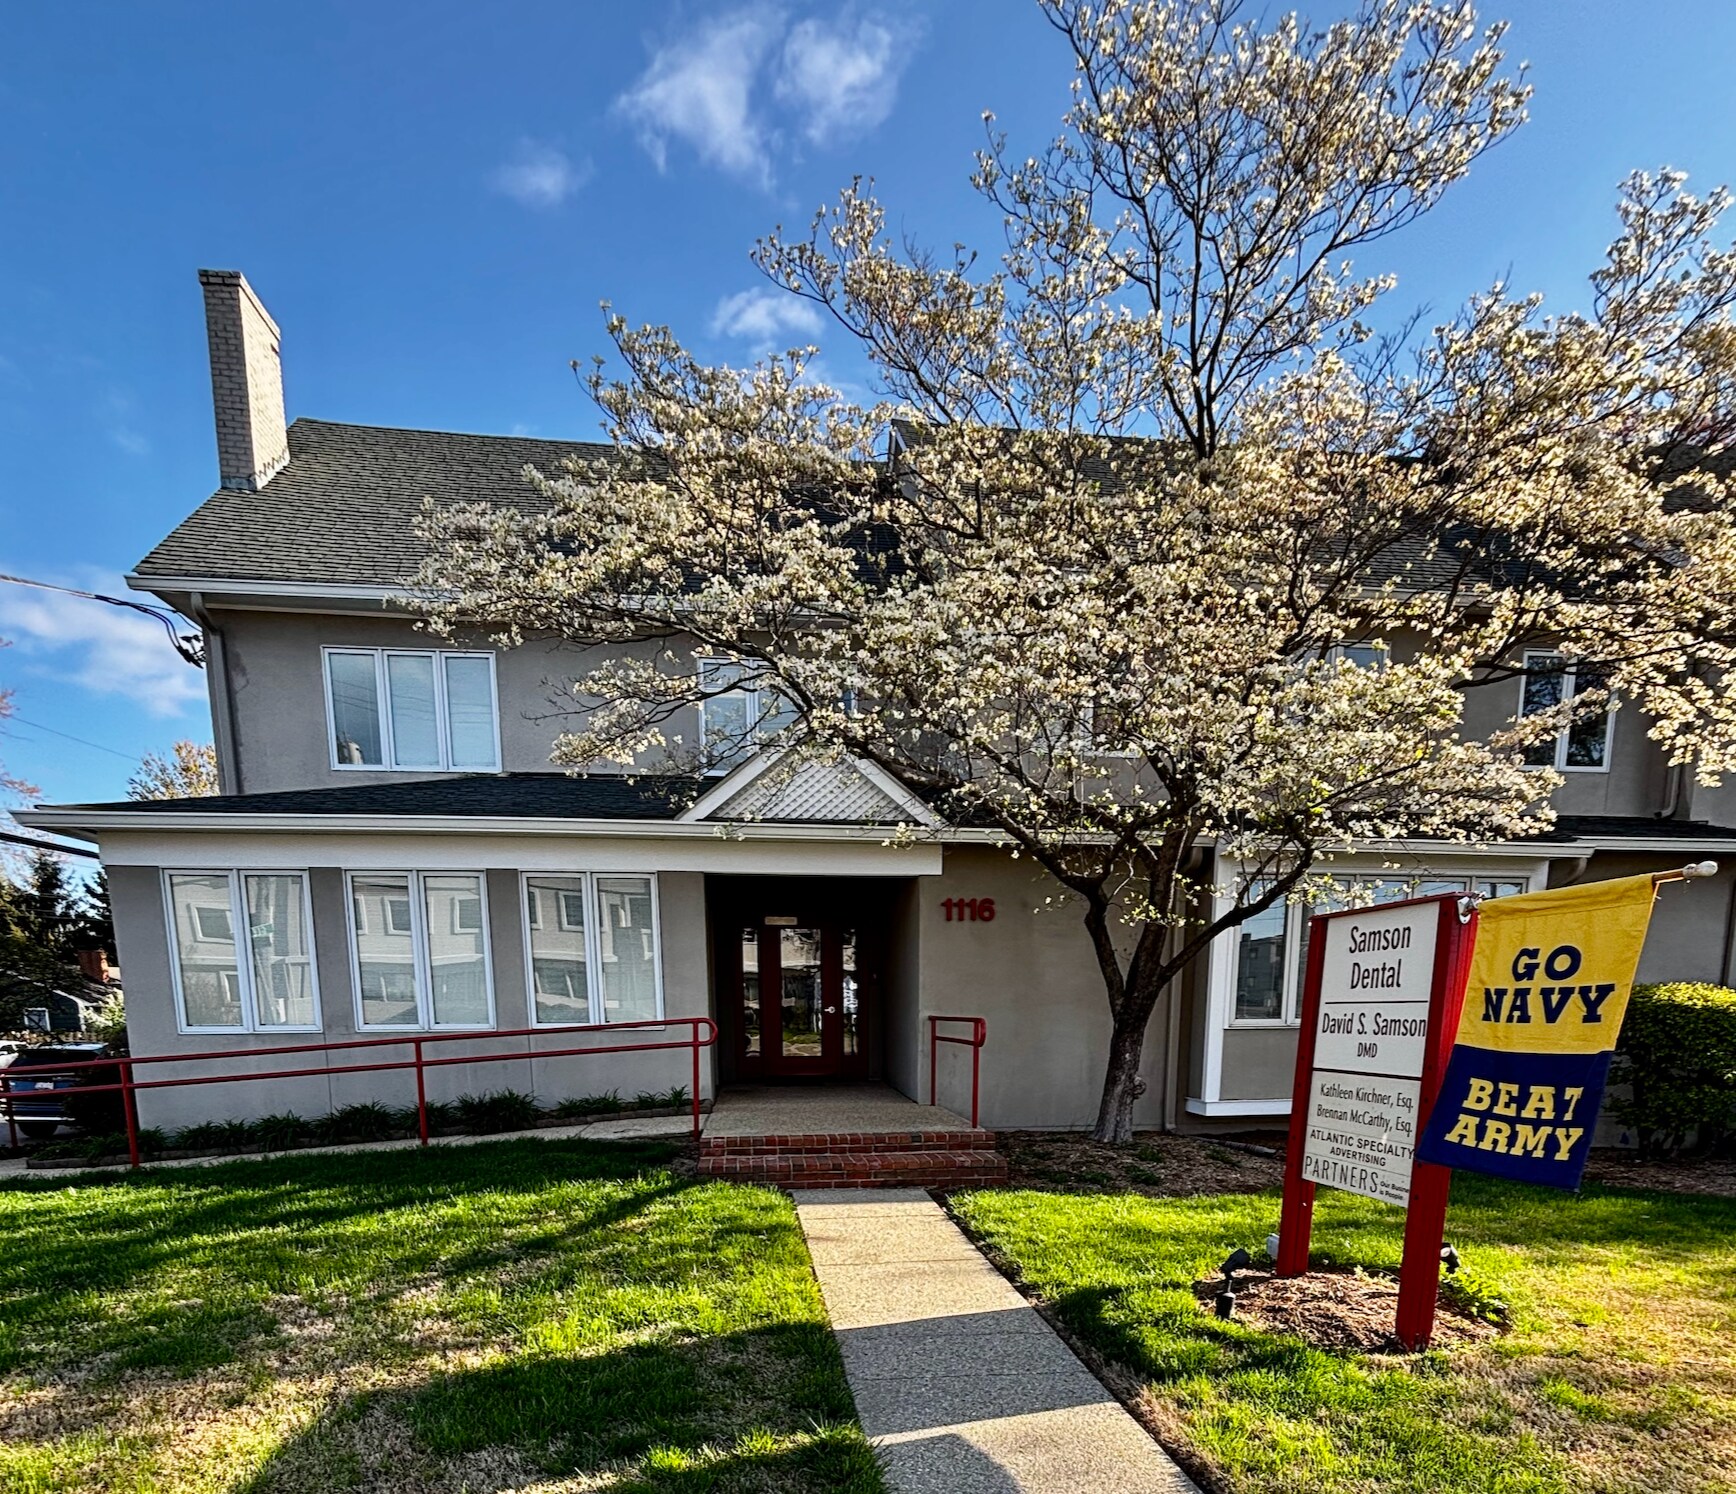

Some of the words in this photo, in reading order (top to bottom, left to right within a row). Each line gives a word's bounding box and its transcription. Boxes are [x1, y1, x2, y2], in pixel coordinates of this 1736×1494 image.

[940, 897, 996, 922] 1116
[1349, 926, 1411, 953] Samson
[1350, 959, 1402, 989] Dental
[1511, 945, 1582, 982] GO
[1481, 983, 1615, 1024] NAVY
[1322, 1013, 1354, 1034] David
[1357, 1013, 1367, 1035] S.
[1372, 1013, 1427, 1037] Samson
[1357, 1042, 1378, 1058] DMD
[1320, 1083, 1353, 1100] Kathleen
[1355, 1087, 1394, 1108] Kirchner,
[1396, 1093, 1414, 1113] Esq.
[1462, 1077, 1584, 1121] BEAT
[1317, 1104, 1348, 1121] Brennan
[1349, 1109, 1393, 1133] McCarthy,
[1395, 1116, 1412, 1137] Esq.
[1310, 1129, 1354, 1147] ATLANTIC
[1356, 1138, 1415, 1160] SPECIALTY
[1444, 1113, 1584, 1161] ARMY
[1330, 1146, 1386, 1167] ADVERTISING
[1304, 1155, 1379, 1193] PARTNERS
